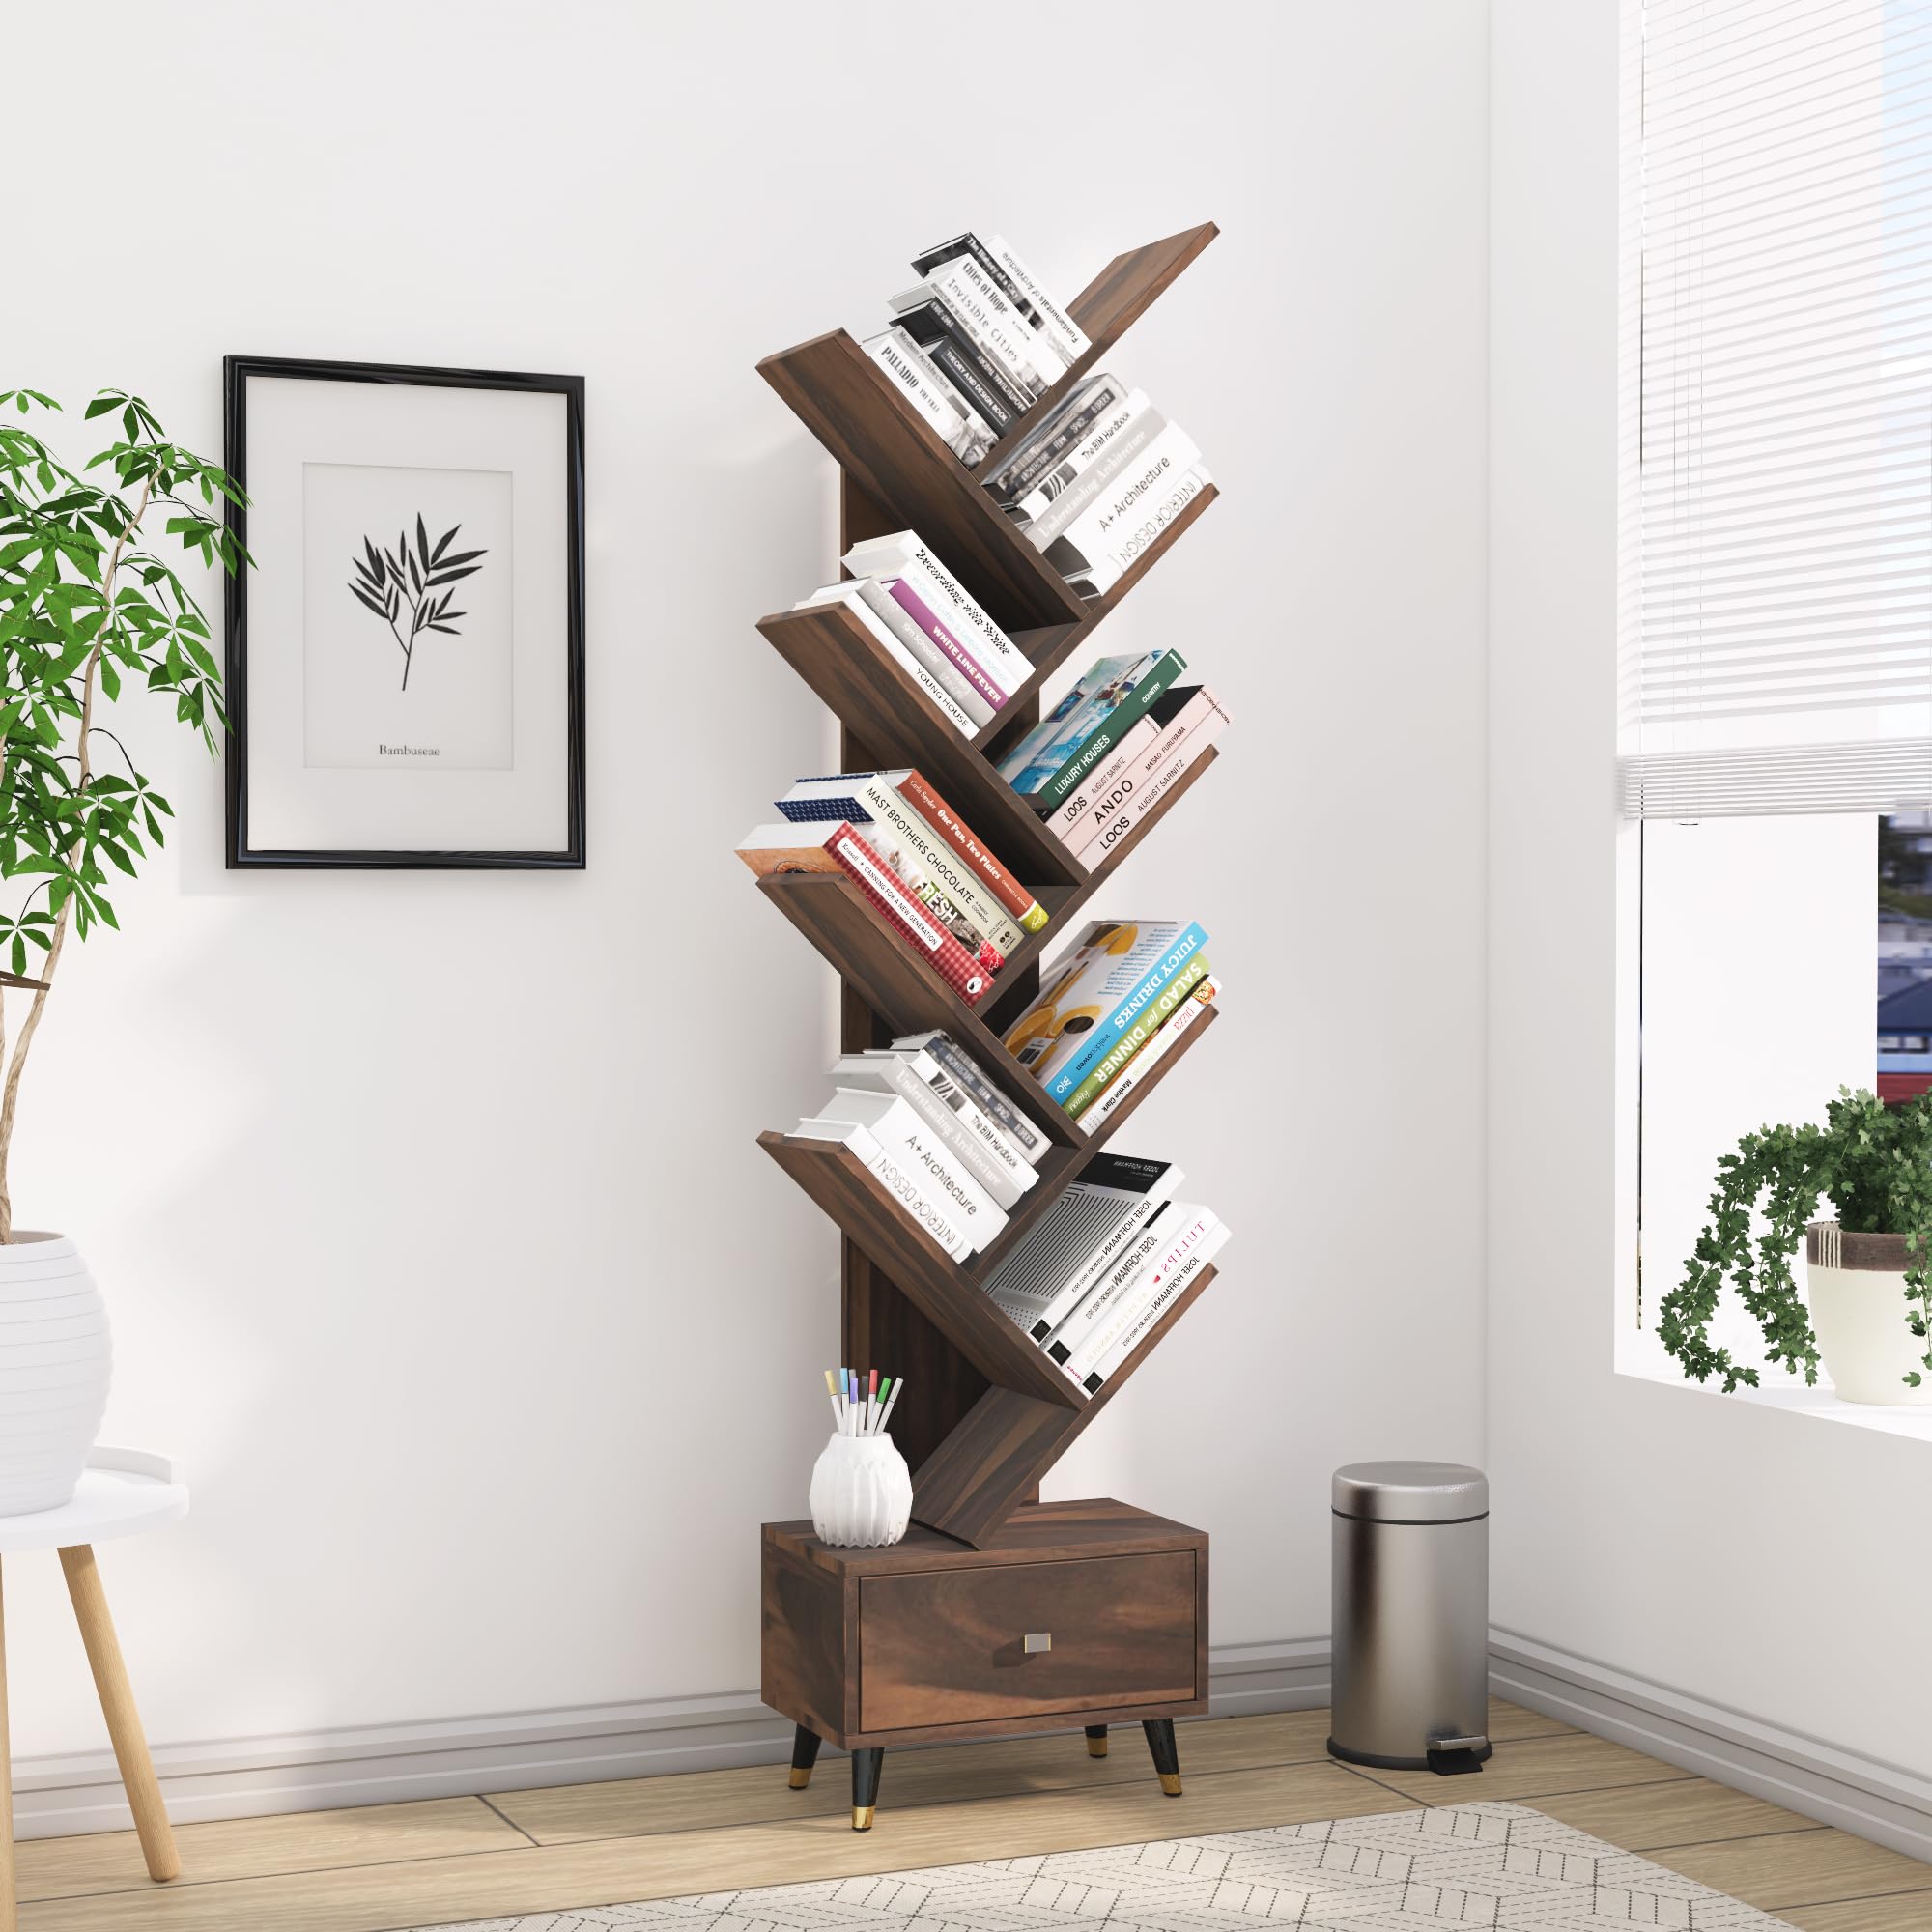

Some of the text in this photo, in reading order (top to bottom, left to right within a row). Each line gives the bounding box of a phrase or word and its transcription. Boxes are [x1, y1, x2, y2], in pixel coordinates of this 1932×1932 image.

[961, 261, 1009, 315] Cities of Hope
[945, 278, 992, 328] Invisible
[988, 327, 1022, 362] Cities
[880, 345, 920, 388] PALLADIO
[897, 330, 951, 390] Modern Architecture
[944, 350, 1009, 422] THEORY AND DESIGN BOOK
[1080, 410, 1131, 460] The BIM Handbook
[1095, 455, 1171, 531] A+ Architecture
[1118, 480, 1197, 562] INTERIOR DESIGN
[912, 548, 967, 607] Decorating
[931, 625, 959, 656] WHITE
[955, 653, 977, 675] LINE
[973, 672, 1001, 703] FEVER
[1140, 681, 1162, 703] COUNTRY
[914, 668, 944, 699] YOUNG
[942, 697, 968, 726] HOUSE
[379, 744, 440, 756] Bambuseae
[1054, 734, 1110, 795] LUXURY HOUSES
[1091, 725, 1186, 824] ANDO MASAO FURUYAMA
[1063, 756, 1125, 822] LOOS AUGUST SARNITZ
[1098, 759, 1185, 850] LOOS AUGUST SARNITZ
[865, 785, 975, 904] MAST BROTHERS CHOCOLATE
[909, 779, 923, 794] Carla
[936, 808, 953, 826] One
[949, 823, 968, 843] Pan,
[964, 839, 981, 858] Two
[978, 854, 1002, 880] Plates
[864, 865, 888, 891] CANNING
[884, 887, 896, 900] FOR
[896, 901, 911, 916] NEW
[907, 913, 938, 946] GENERATION
[910, 875, 958, 926] FRESH
[971, 904, 988, 923] COOKBOOK
[1159, 933, 1199, 977] JUICY
[1113, 972, 1164, 1029] DRINKS
[1157, 961, 1203, 1011] SALAD
[1141, 1008, 1161, 1028] for
[1074, 1032, 1111, 1071] weldonowen
[1093, 1025, 1146, 1083] DINNER
[1100, 1005, 1196, 1113] pizza Maxine Clark
[969, 1114, 1019, 1169] The BIM Handbook
[876, 1158, 958, 1245] INTERIOR DESIGN
[904, 1133, 979, 1216] A+ Architecture
